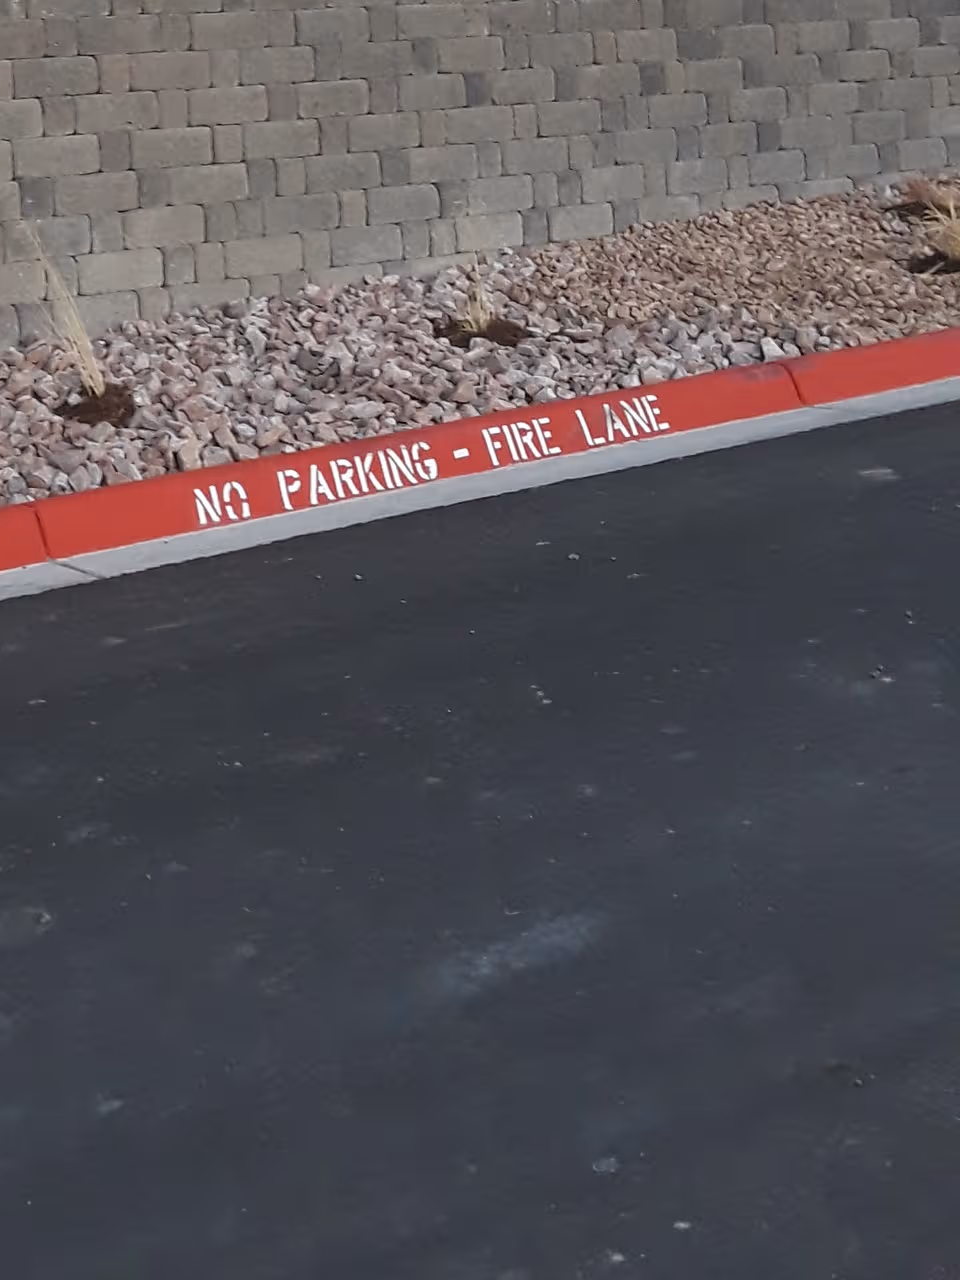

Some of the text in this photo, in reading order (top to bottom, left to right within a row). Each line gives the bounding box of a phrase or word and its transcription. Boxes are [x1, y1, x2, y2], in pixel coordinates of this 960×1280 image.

[193, 395, 670, 525] NO PARKING - FIRE LANE
